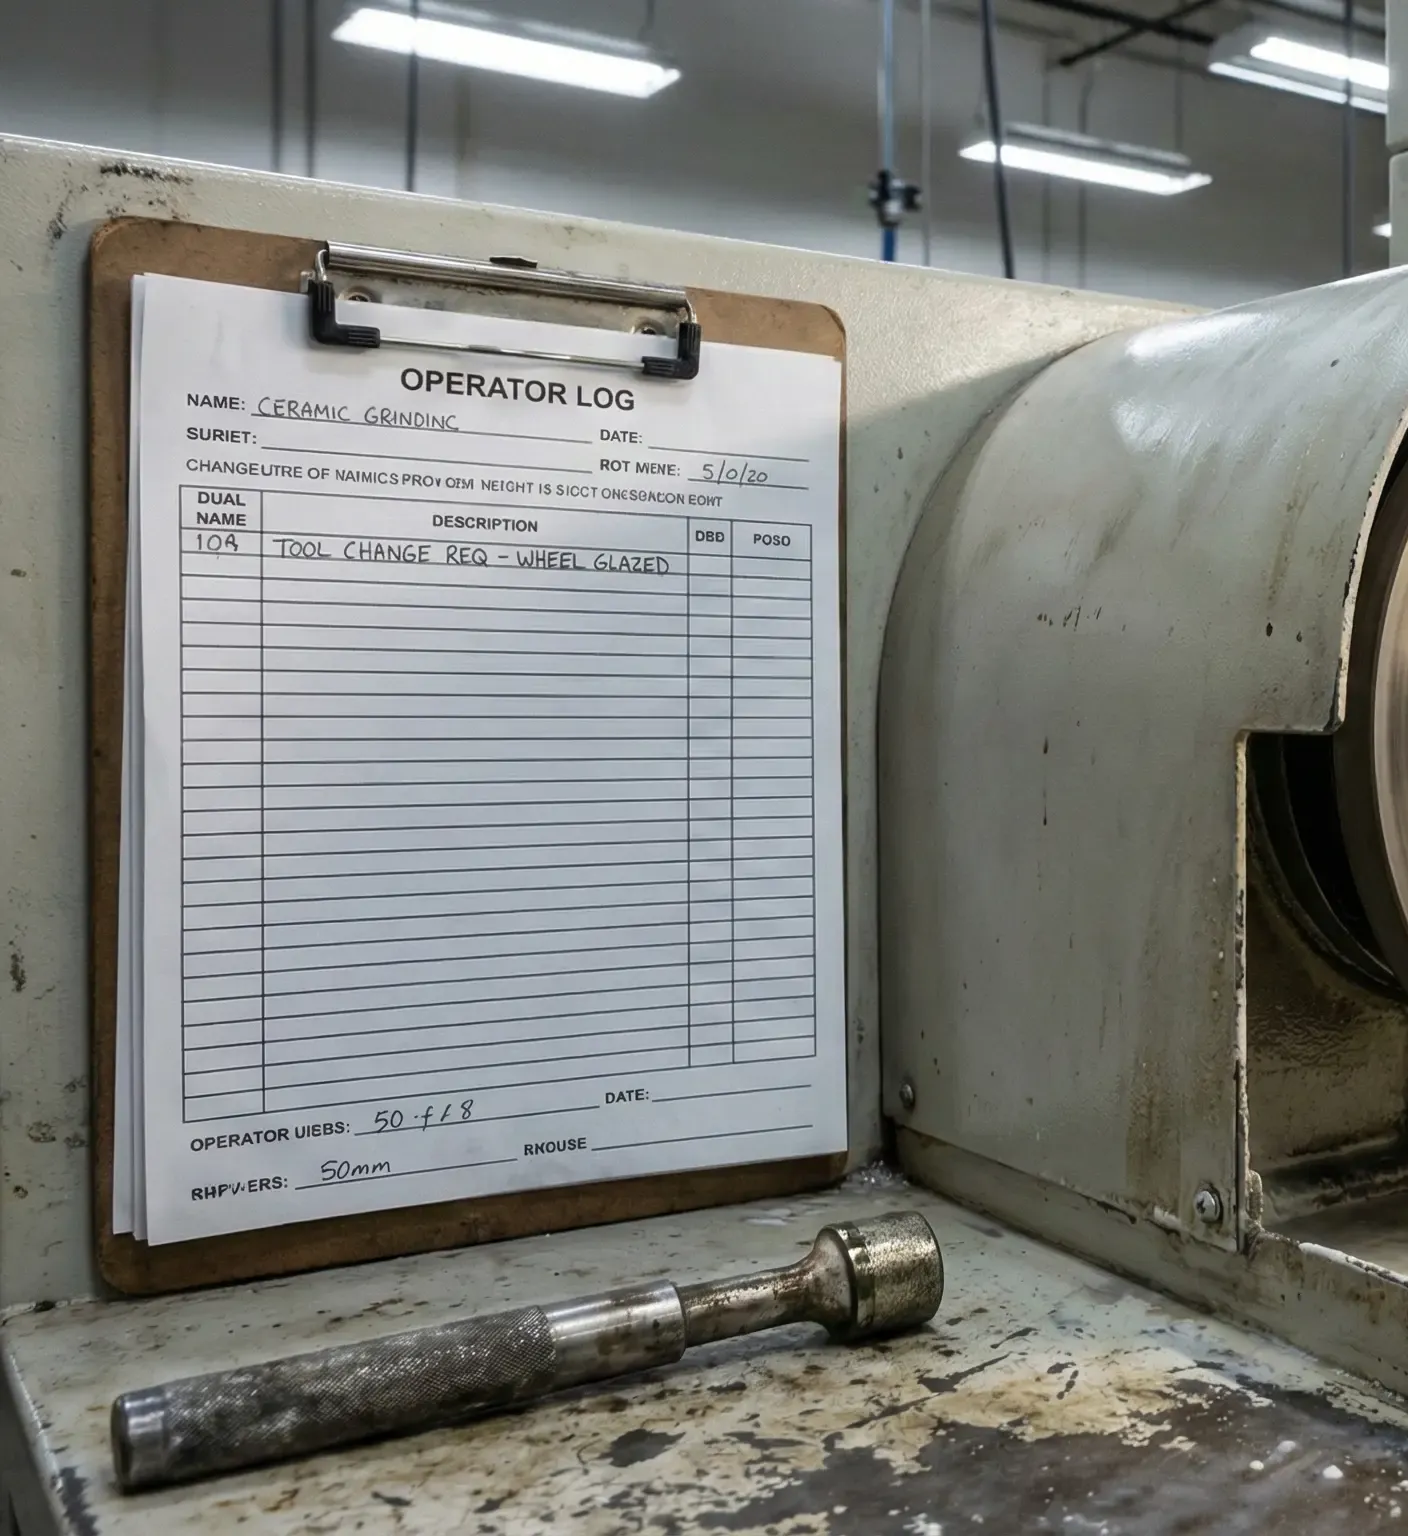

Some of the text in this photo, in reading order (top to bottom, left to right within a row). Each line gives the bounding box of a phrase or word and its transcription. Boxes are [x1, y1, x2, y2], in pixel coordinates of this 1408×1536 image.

[400, 368, 635, 411] OPERATOR LOG
[187, 393, 246, 411] NAME:
[257, 396, 351, 421] CERAMIC
[186, 427, 257, 444] SURIET:
[600, 429, 643, 444] DATE:
[600, 459, 631, 473] ROT
[307, 467, 330, 480] OF
[539, 483, 552, 495] IS
[197, 491, 246, 507] DUAL
[196, 512, 247, 526] NAME
[432, 514, 538, 532] DESCRIPTION
[272, 538, 332, 558] TOOL
[343, 540, 431, 563] CHANGE
[446, 544, 488, 567] REQ
[516, 549, 586, 570] WHEEL
[593, 552, 670, 576] GLAZED
[605, 1089, 650, 1105] DATE:
[374, 1110, 403, 1134] 50
[190, 1127, 290, 1152] OPERATOR
[320, 1160, 391, 1182] 50mm
